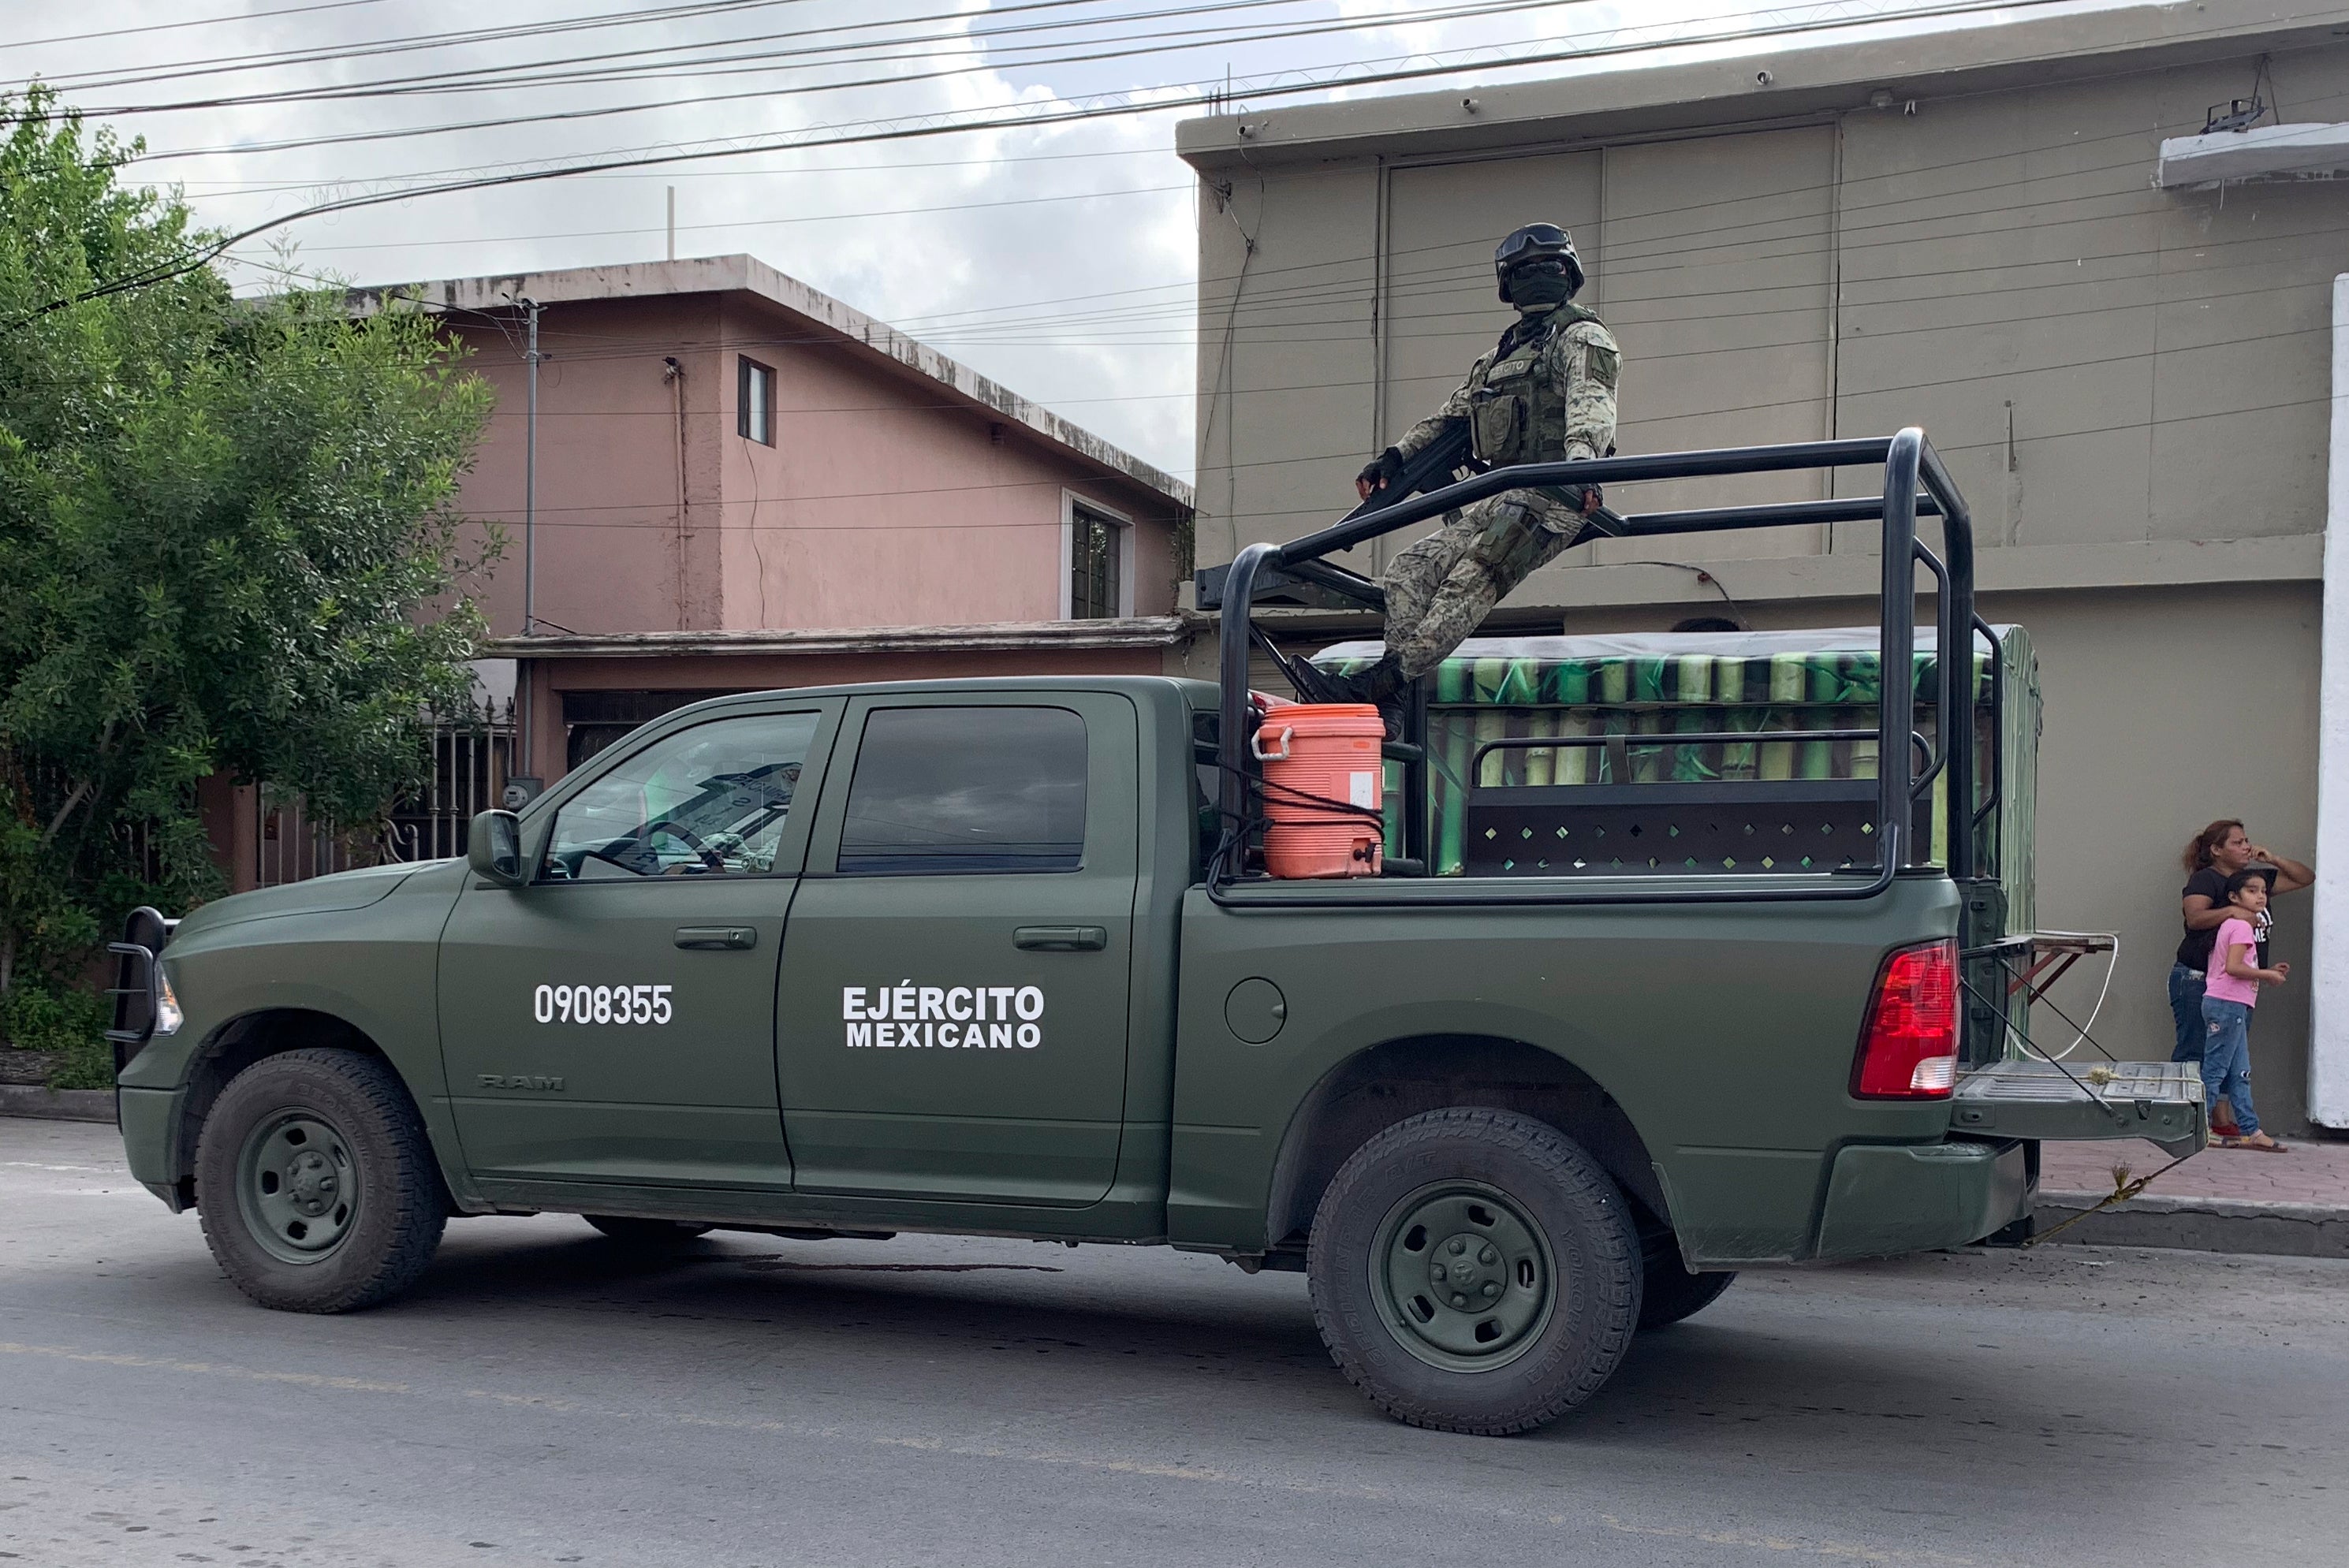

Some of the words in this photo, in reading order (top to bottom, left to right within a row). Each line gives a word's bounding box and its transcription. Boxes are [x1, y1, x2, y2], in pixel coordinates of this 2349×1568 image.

[535, 984, 673, 1025] 0908355
[843, 978, 1045, 1021] EJÉRCITO
[846, 1022, 1042, 1049] MEXICANO
[476, 1073, 566, 1092] RAM
